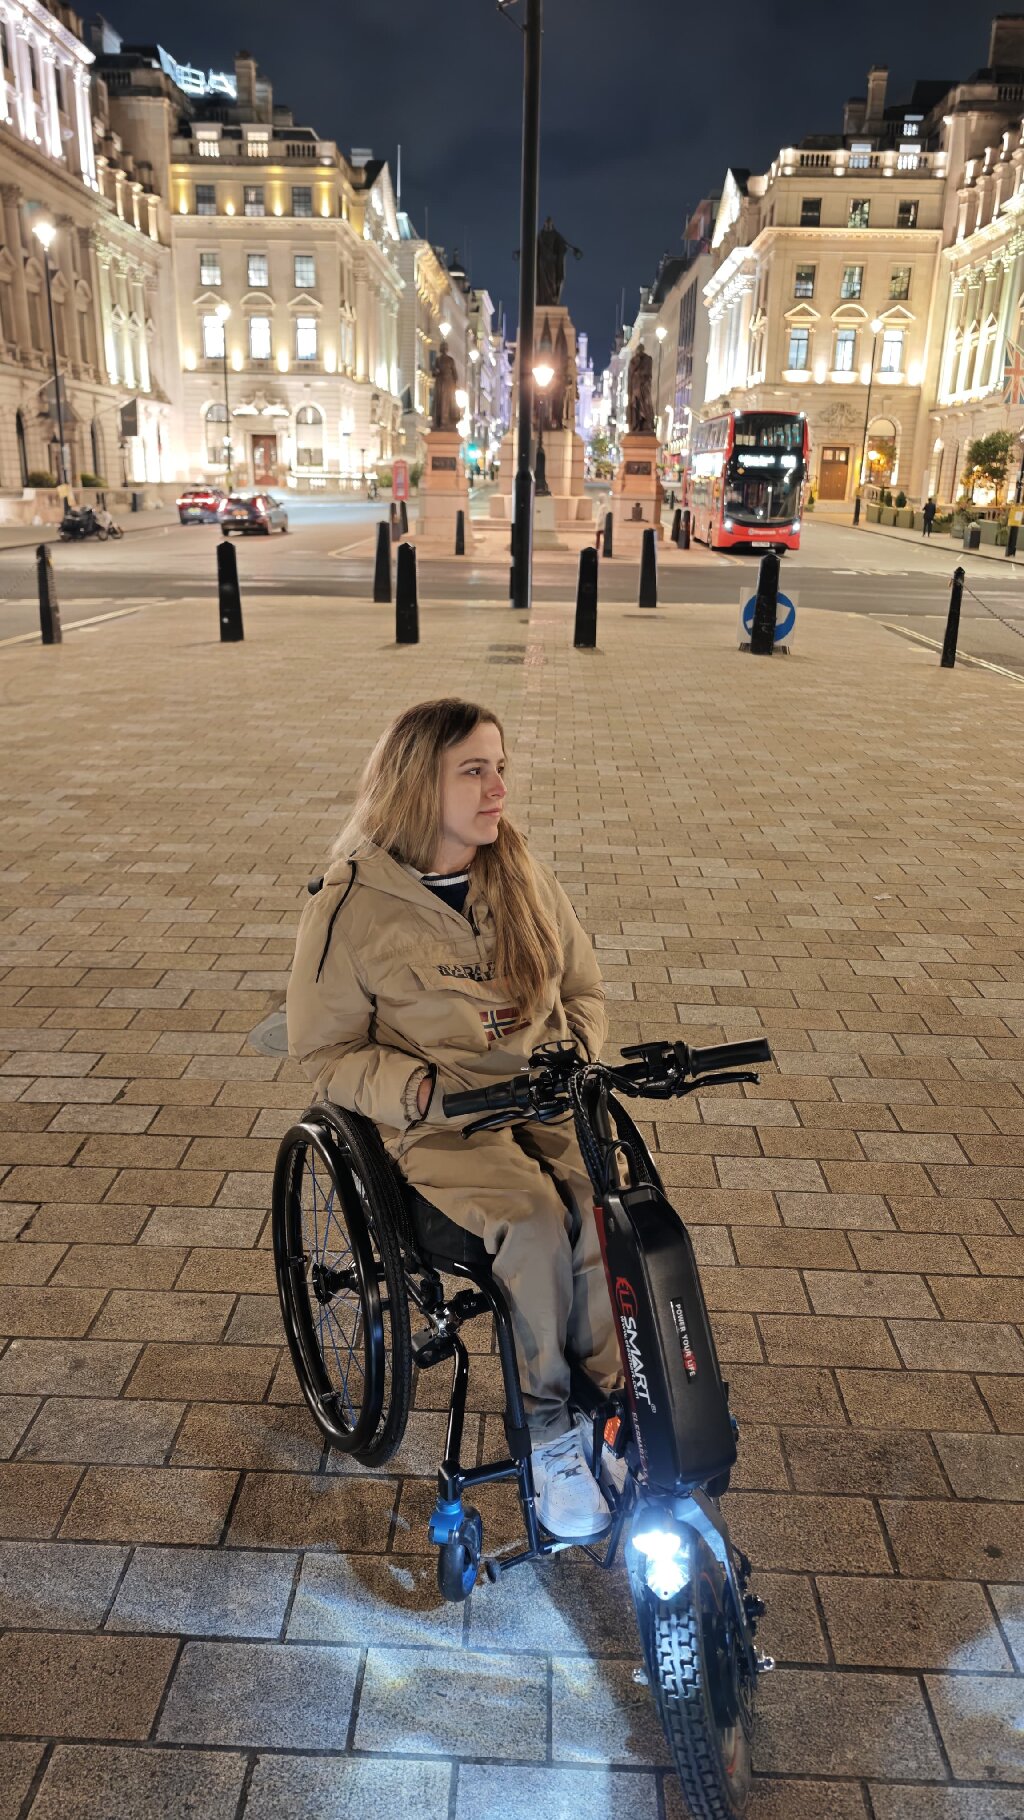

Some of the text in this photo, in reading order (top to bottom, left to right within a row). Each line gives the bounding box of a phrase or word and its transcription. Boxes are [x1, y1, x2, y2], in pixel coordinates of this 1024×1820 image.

[675, 1303, 696, 1377] POWER YOUR LIFE
